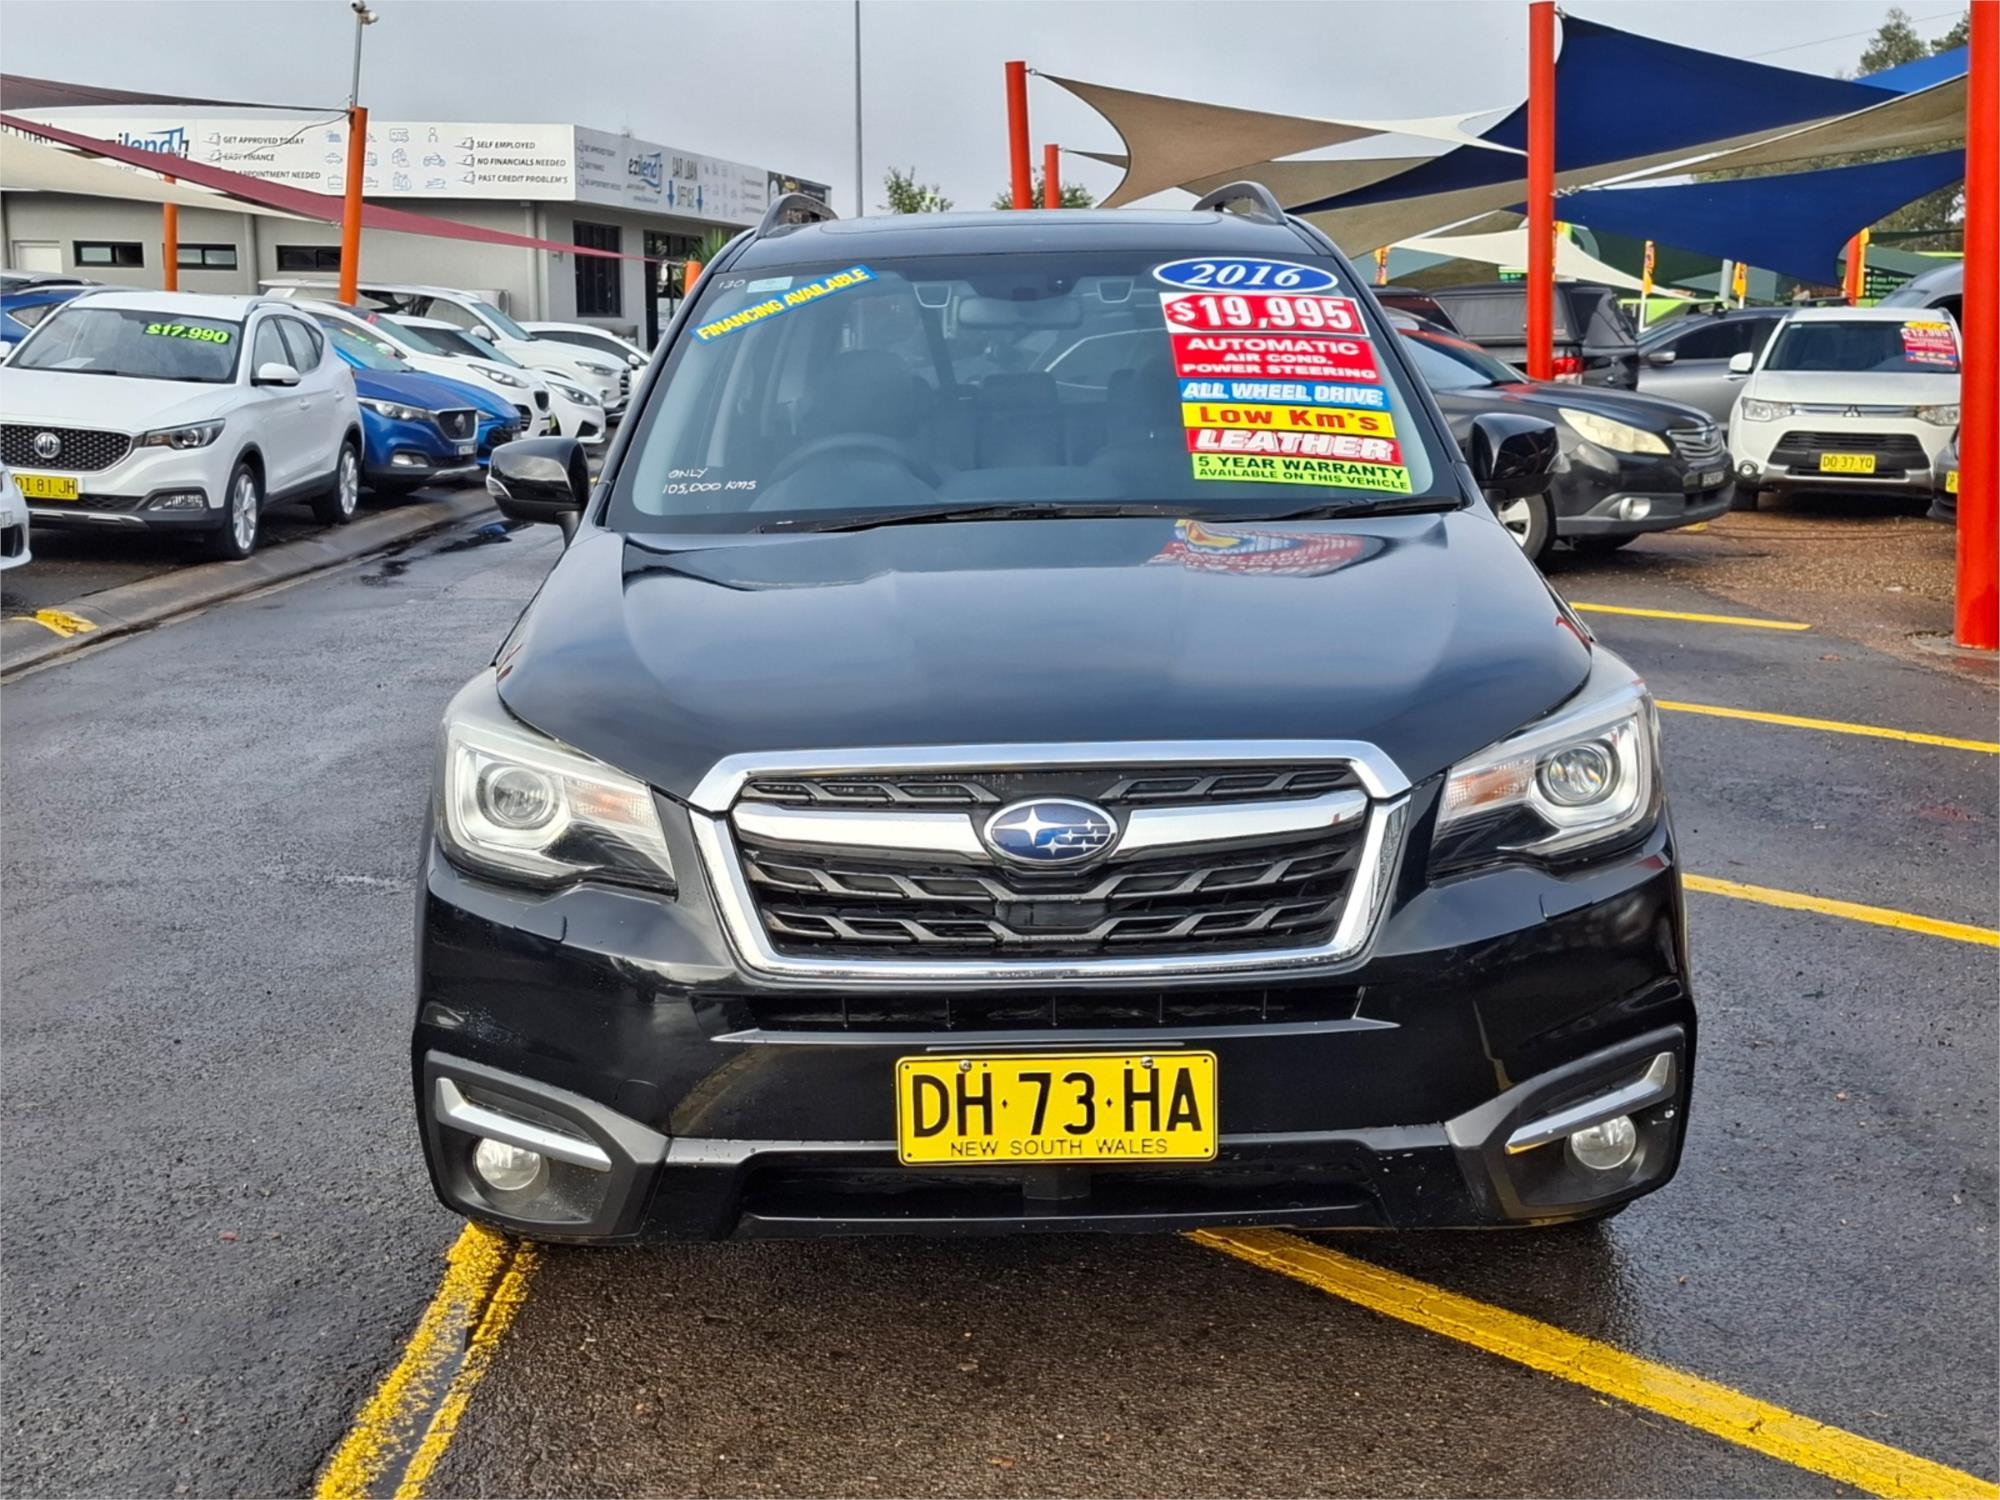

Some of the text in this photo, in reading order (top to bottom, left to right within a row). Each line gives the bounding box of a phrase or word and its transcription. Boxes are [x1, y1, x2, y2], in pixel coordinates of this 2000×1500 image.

[223, 136, 237, 144] GET
[238, 136, 278, 144] APPROVED
[476, 141, 536, 149] SELF EMPLOYED
[477, 158, 567, 167] NO FINANCIALS NEEDED
[478, 174, 496, 182] PAST
[497, 174, 524, 183] CREDIT
[1184, 263, 1305, 287] 2016
[697, 268, 870, 340] FINANCING AVAILABLE
[1170, 295, 1353, 329] $19,995
[1187, 338, 1360, 356] AUTOMATIC
[1223, 353, 1334, 365] AIR COND.
[1182, 363, 1377, 379] POWER STEERING
[1182, 382, 1384, 406] ALL WHEEL DRIVE
[1289, 410, 1380, 431] Km's
[1195, 428, 1394, 462] LEATHER
[668, 467, 709, 479] ONLY
[1198, 456, 1405, 479] 5 YEAR WARRANTY
[58, 480, 76, 495] JH
[1199, 468, 1409, 490] AVAILABLE ON THIS VEHICLE
[663, 482, 722, 495] 105,000
[951, 1138, 1168, 1156] NEW SOUTH WALES
